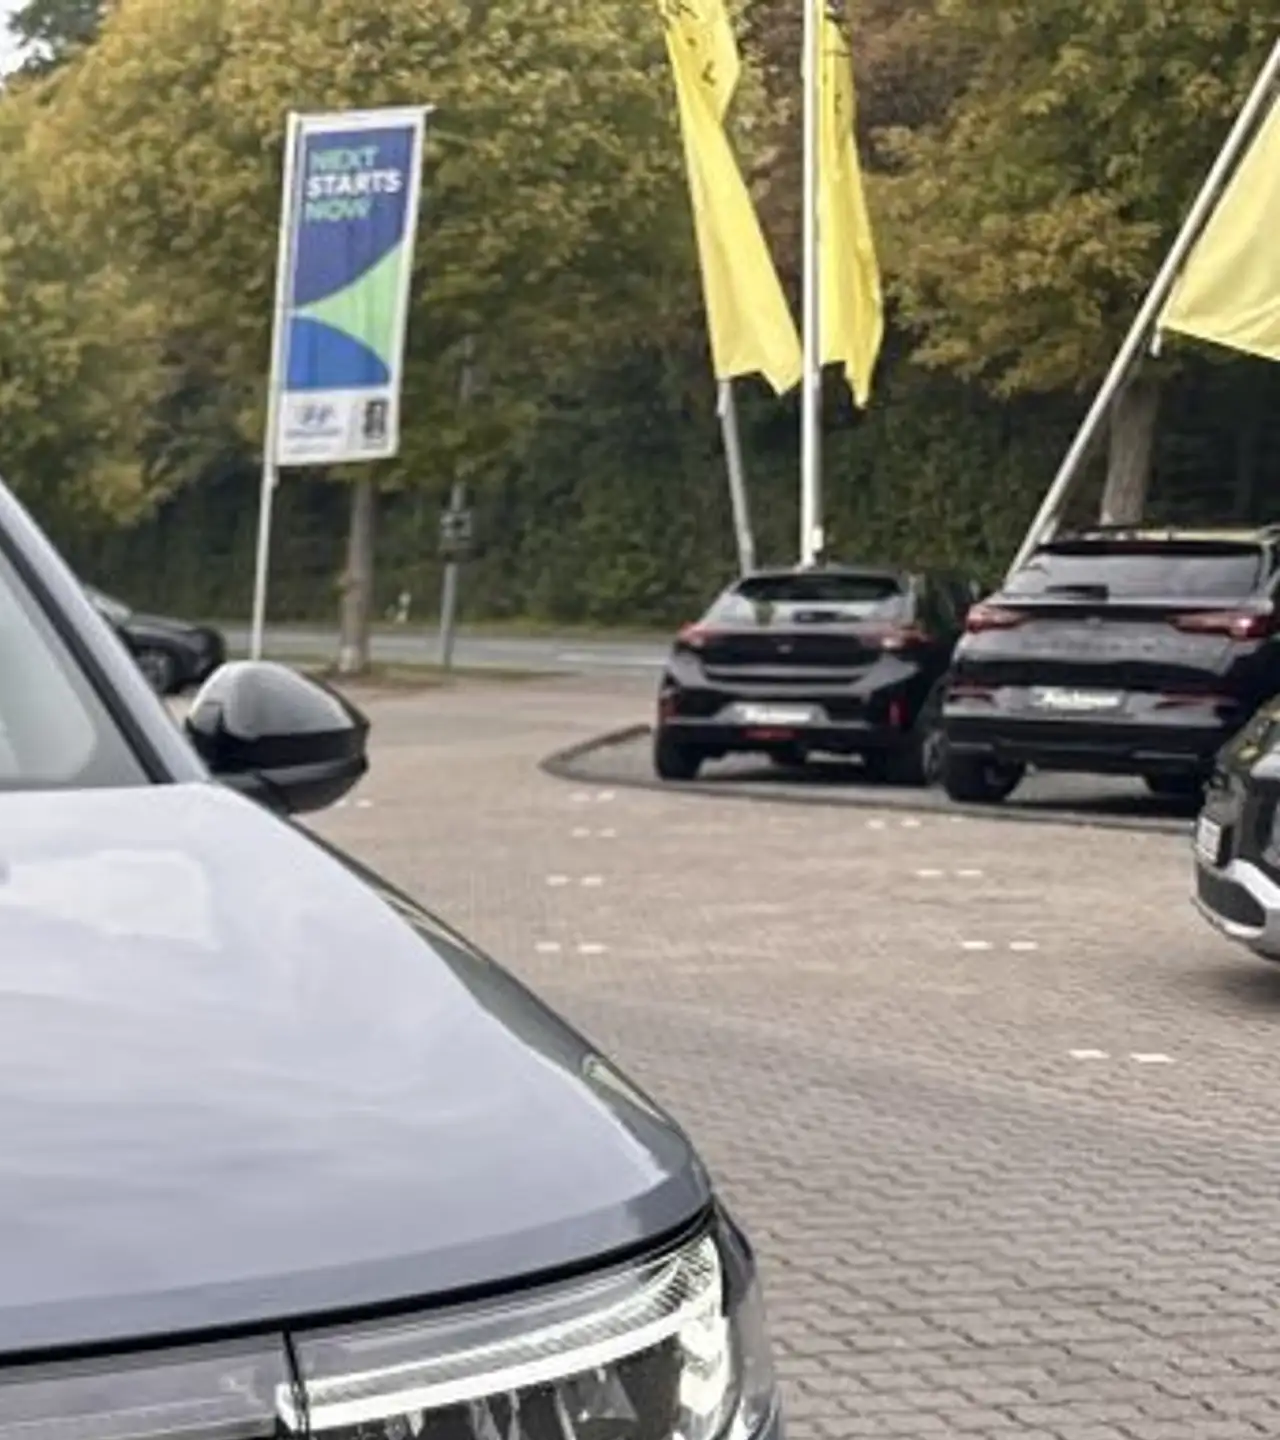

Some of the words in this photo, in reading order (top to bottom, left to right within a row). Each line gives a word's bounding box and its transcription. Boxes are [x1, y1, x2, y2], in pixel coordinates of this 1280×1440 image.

[309, 146, 379, 171] NEXT
[306, 168, 403, 198] STARTS
[305, 198, 371, 222] NOW
